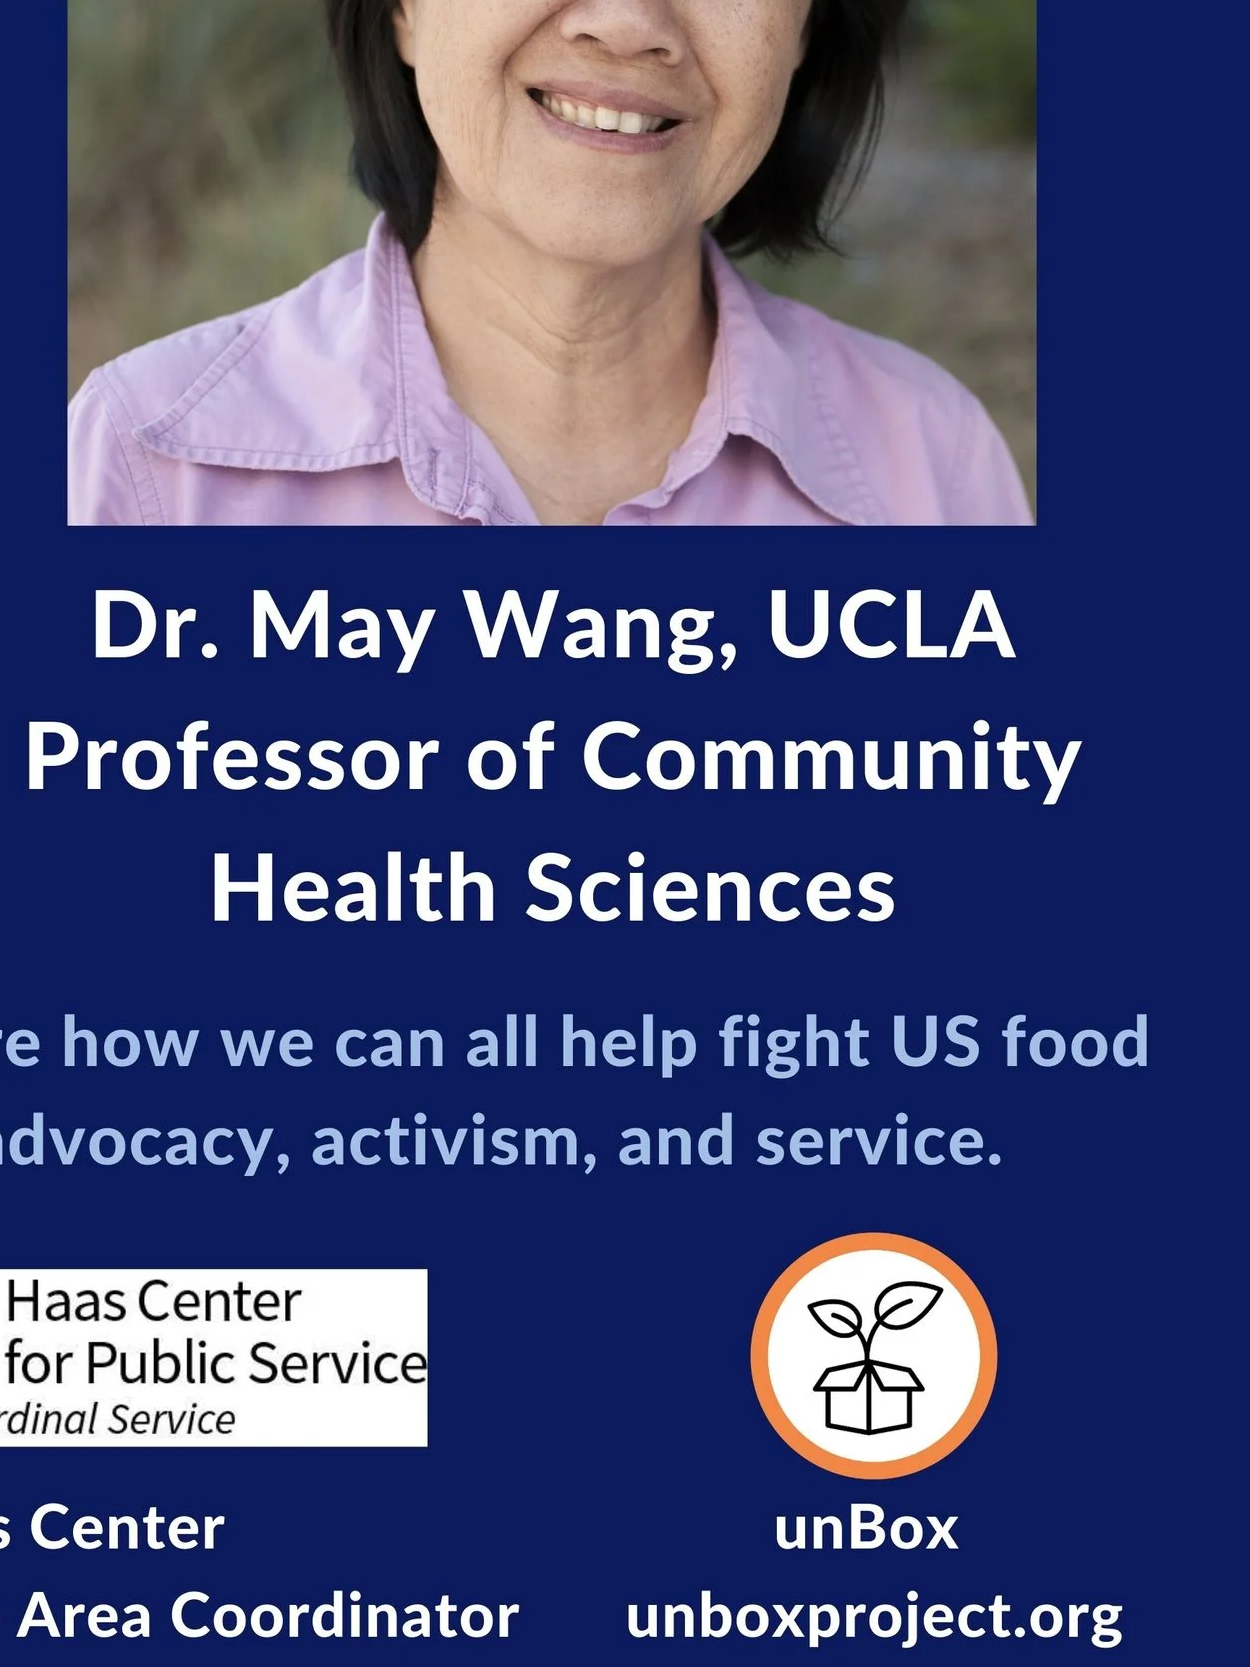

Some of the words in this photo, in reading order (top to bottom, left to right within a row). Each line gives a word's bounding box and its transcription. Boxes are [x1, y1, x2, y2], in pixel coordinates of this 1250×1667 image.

[95, 590, 217, 658] Dr.
[253, 590, 436, 673] May
[462, 590, 736, 674] Wang,
[771, 589, 1016, 658] UCLA
[29, 720, 439, 790] Professor
[468, 720, 555, 790] of
[584, 720, 1082, 805] Community
[214, 851, 493, 922] Health
[526, 851, 894, 922] Sciences
[65, 1014, 199, 1067] how
[220, 1030, 313, 1067] we
[336, 1029, 443, 1067] can
[467, 1014, 536, 1067] all
[563, 1014, 696, 1078] help
[719, 1014, 870, 1079] fight
[894, 1015, 979, 1067] US
[1002, 1014, 1147, 1067] food
[312, 1112, 596, 1174] activism,
[619, 1112, 732, 1165] and
[757, 1112, 1001, 1165] service.
[8, 1279, 126, 1322] Haas
[139, 1279, 302, 1321] Center
[4, 1338, 74, 1384] for
[88, 1337, 235, 1384] Public
[249, 1340, 426, 1384] Service
[107, 1403, 235, 1434] Service
[31, 1503, 225, 1549] Center
[777, 1503, 959, 1549] unBox
[16, 1592, 150, 1638] Area
[172, 1590, 519, 1638] Coordinator
[628, 1590, 1122, 1648] unboxproject.org
